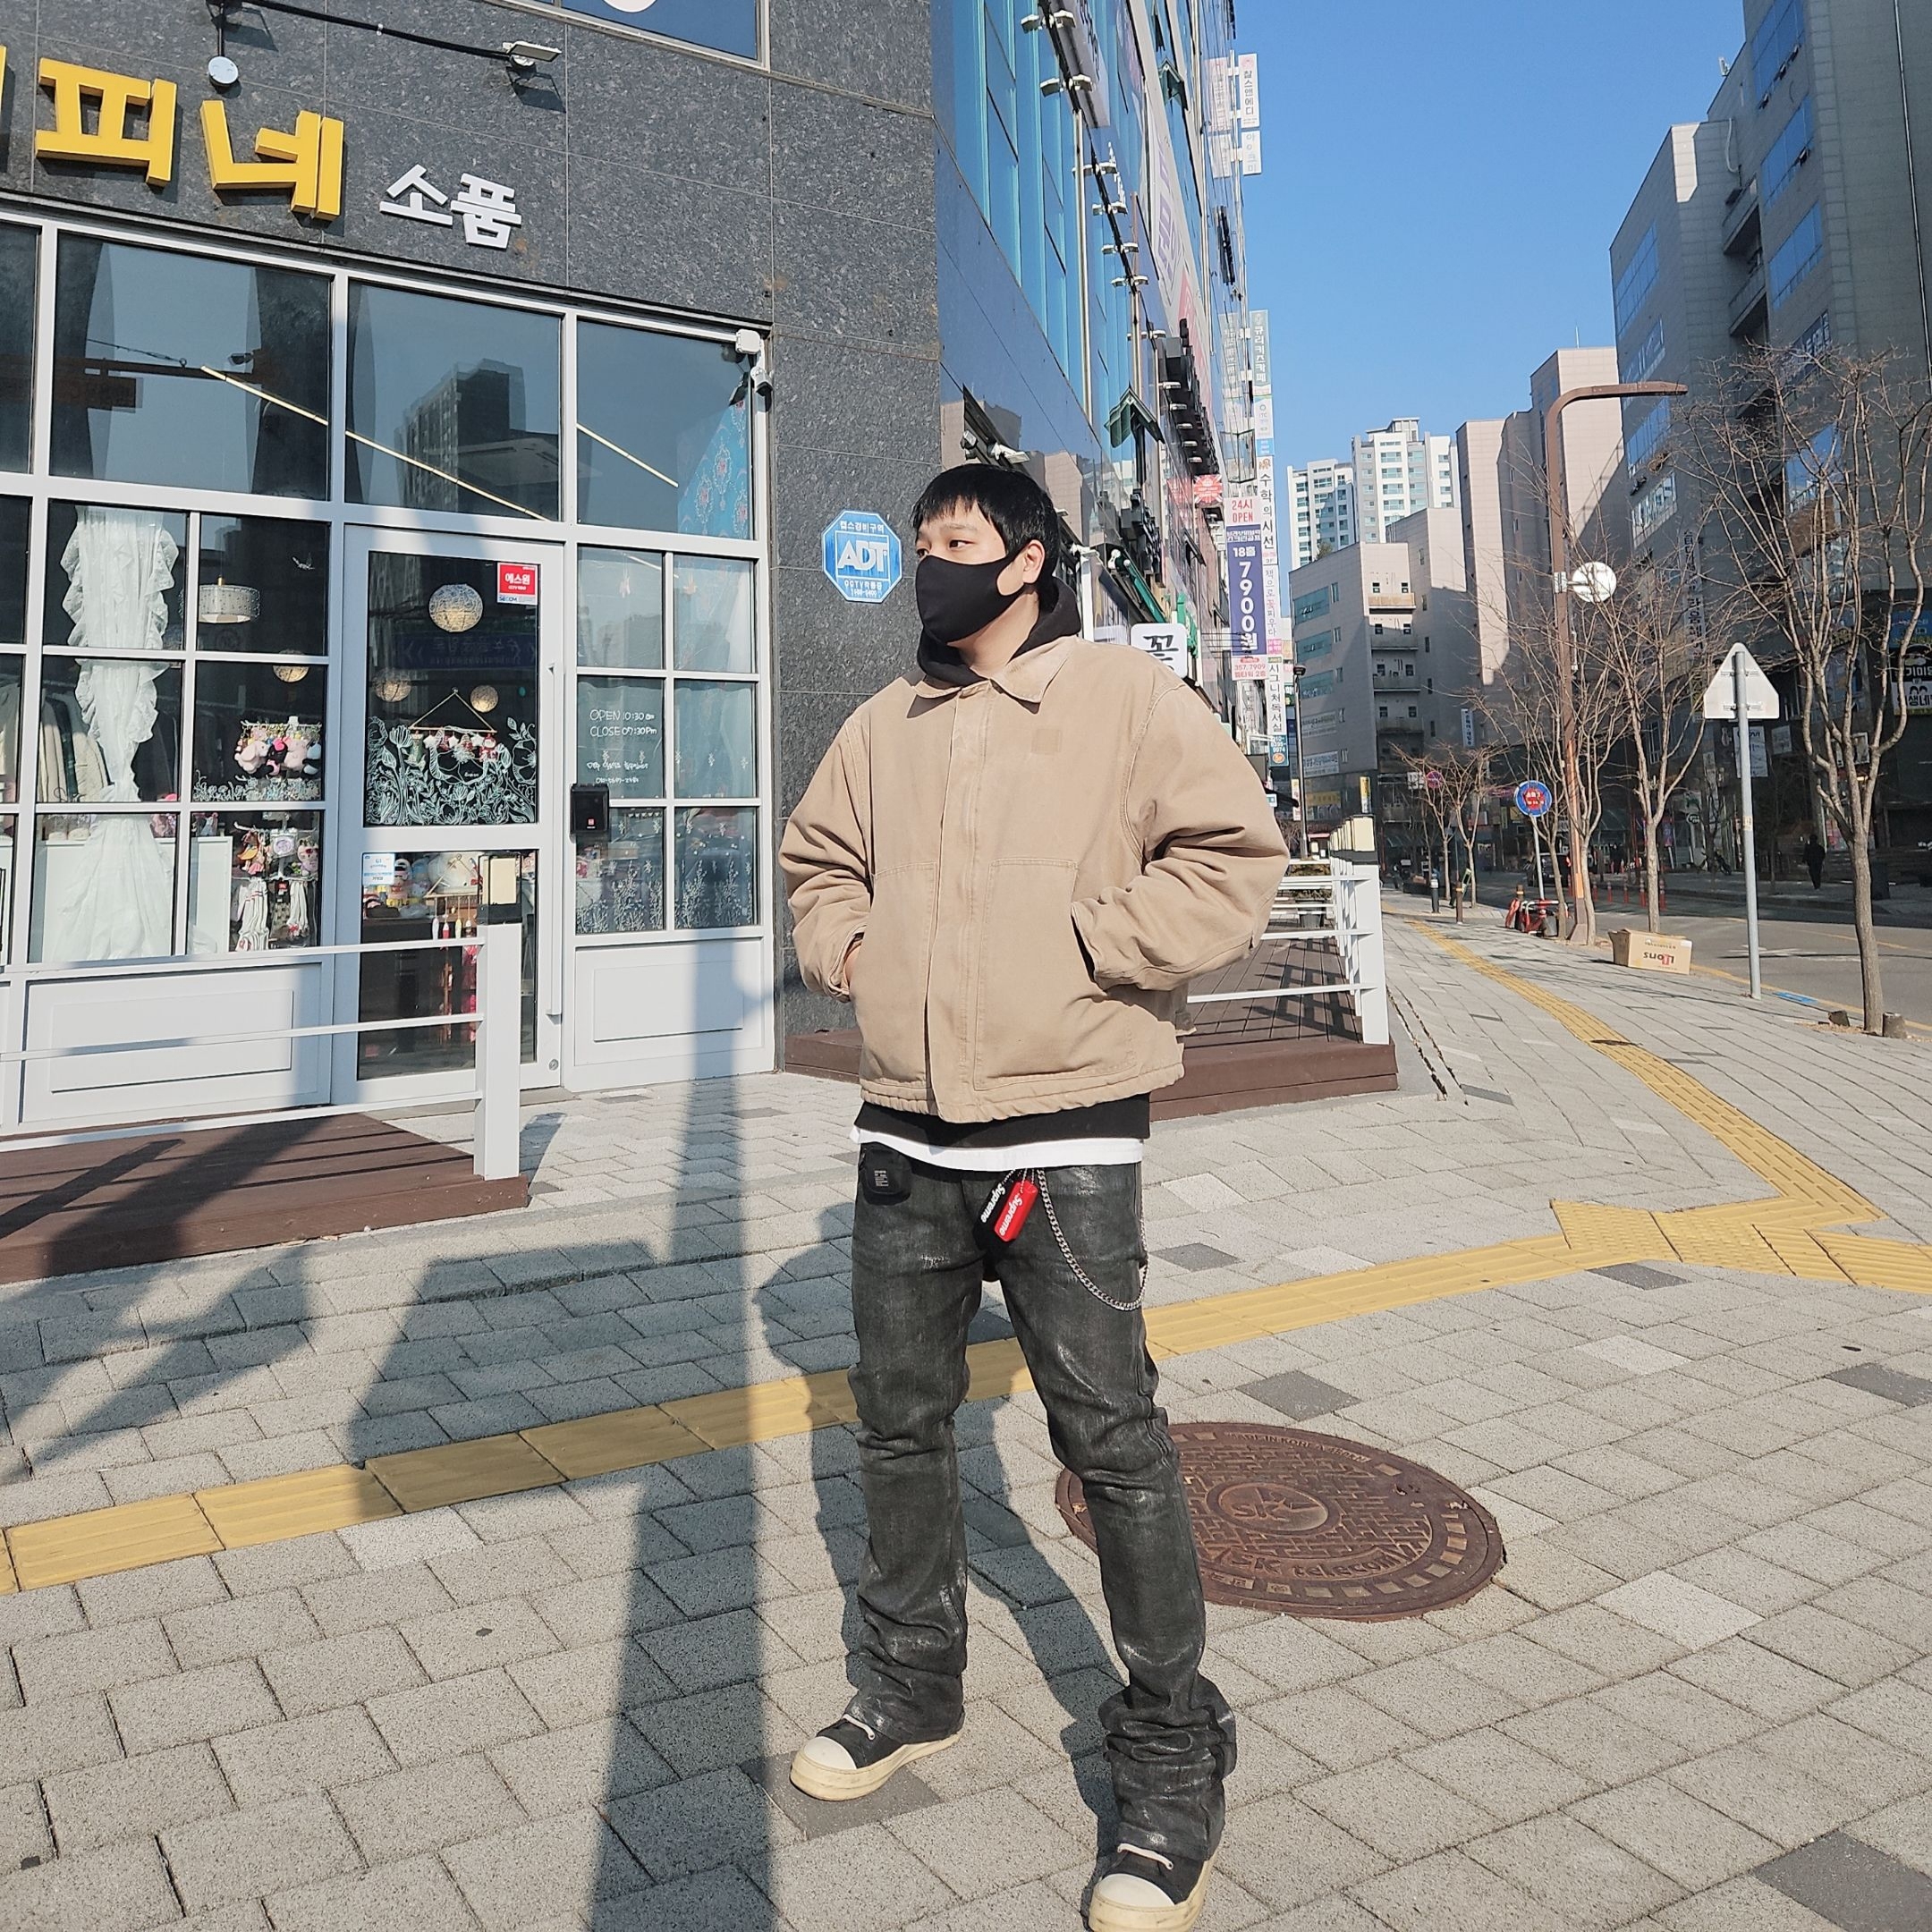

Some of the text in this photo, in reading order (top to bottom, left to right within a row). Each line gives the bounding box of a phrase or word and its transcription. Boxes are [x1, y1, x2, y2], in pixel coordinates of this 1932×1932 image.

[0, 45, 521, 250] 피네 소품
[1232, 499, 1253, 511] 24시
[1233, 512, 1253, 523] OPEN
[837, 539, 888, 572] ADT
[1233, 547, 1256, 558] 18홀
[504, 572, 530, 585] 에스원
[589, 709, 621, 721] OPEN
[623, 711, 645, 721] 10:30
[589, 725, 621, 737] CLOSE
[980, 1182, 1006, 1223] Supreme
[999, 1192, 1023, 1236] Supreme
[1229, 1551, 1402, 1579] SK telecom
